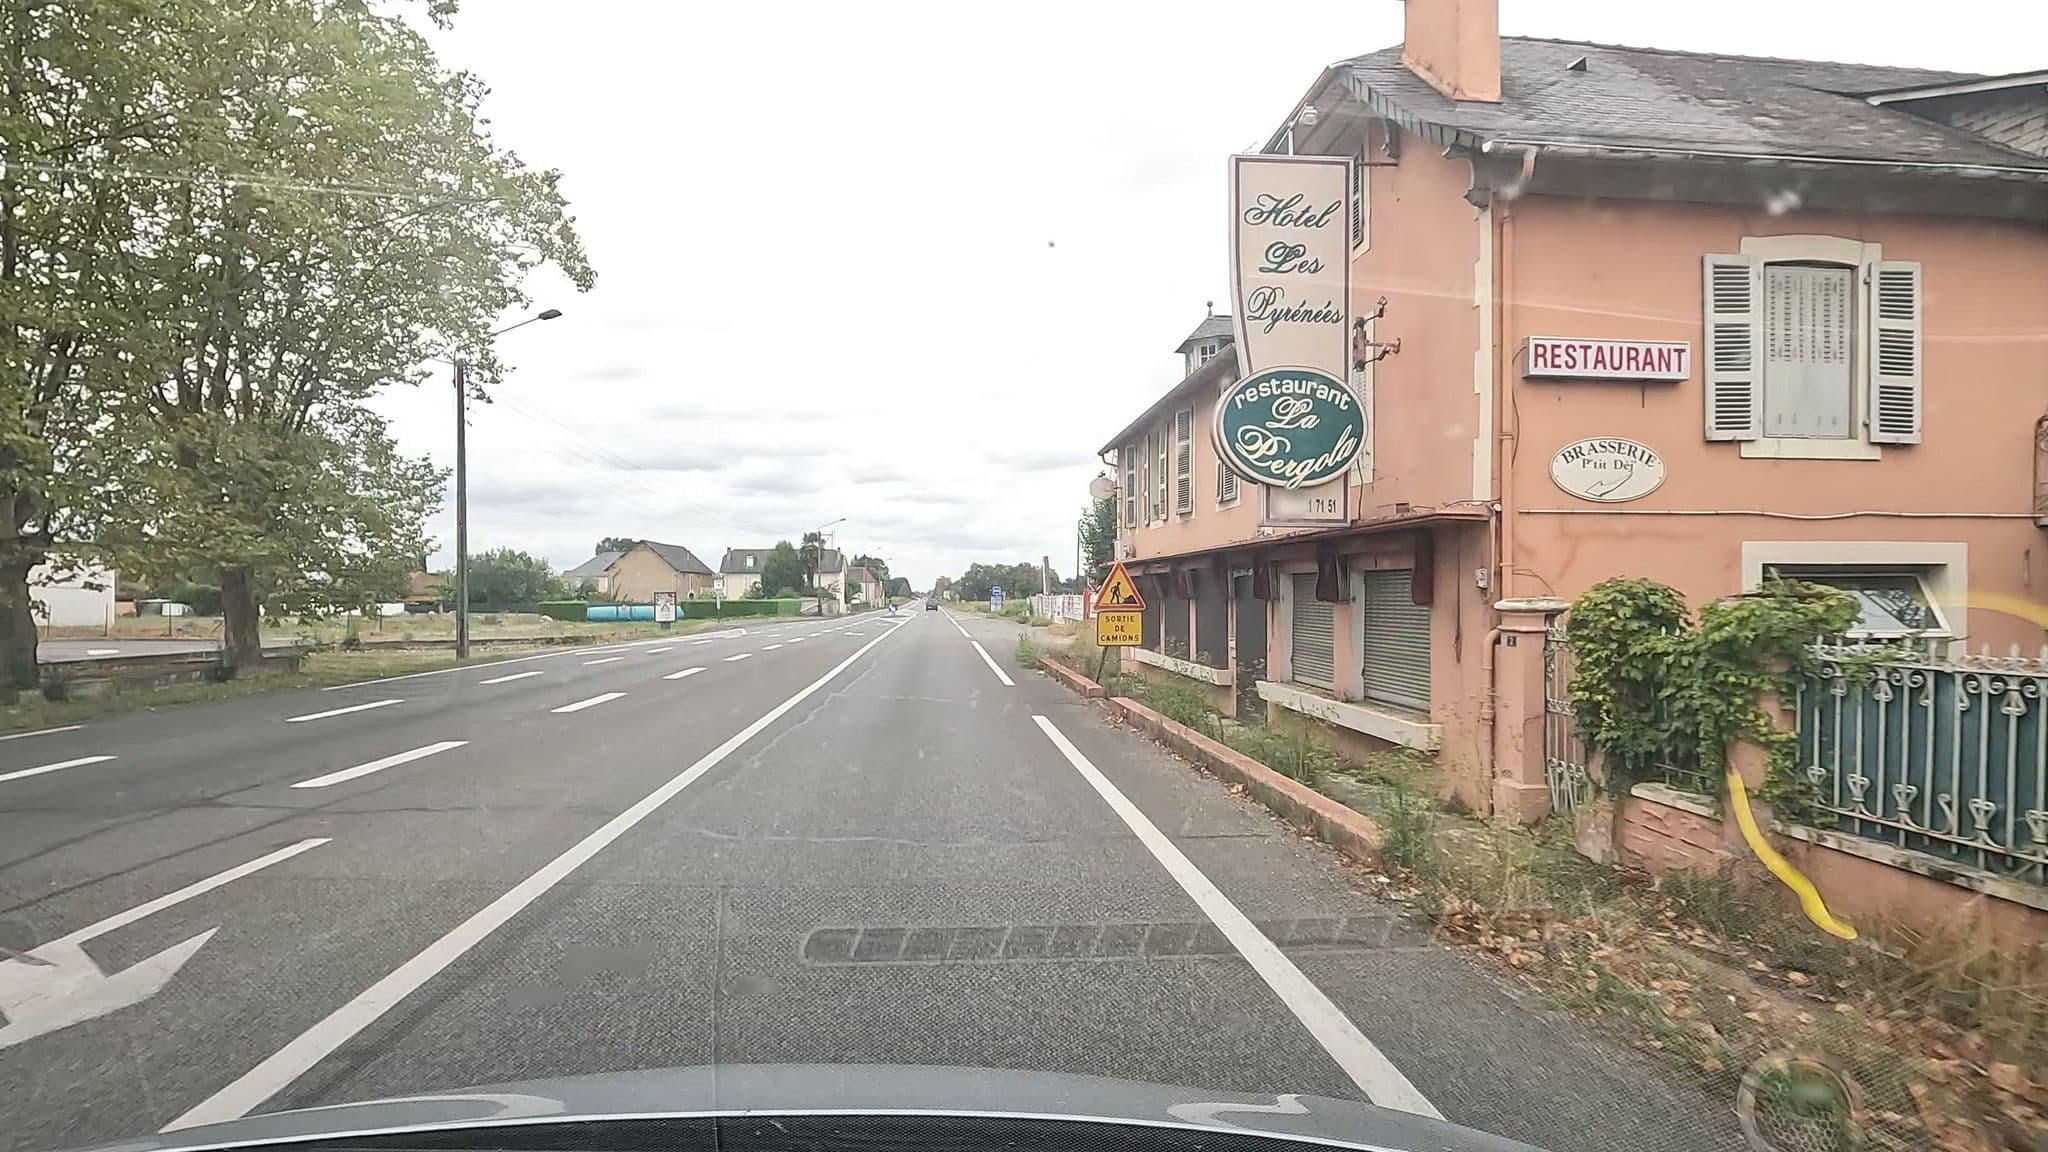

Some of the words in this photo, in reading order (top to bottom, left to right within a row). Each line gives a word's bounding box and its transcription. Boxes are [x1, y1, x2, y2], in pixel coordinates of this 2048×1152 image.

[1244, 194, 1342, 228] Hôtel
[1258, 241, 1324, 274] Les
[1247, 286, 1343, 334] Pyrénées
[1534, 343, 1687, 373] RESTAURANT
[1234, 378, 1351, 410] restaurant
[1265, 396, 1321, 429] La
[1235, 424, 1358, 489] Pergola
[1561, 440, 1657, 468] BRASSERIE
[1327, 499, 1336, 513] 51
[1105, 615, 1136, 623] SORTIE
[1100, 634, 1139, 642] CAMIONS
